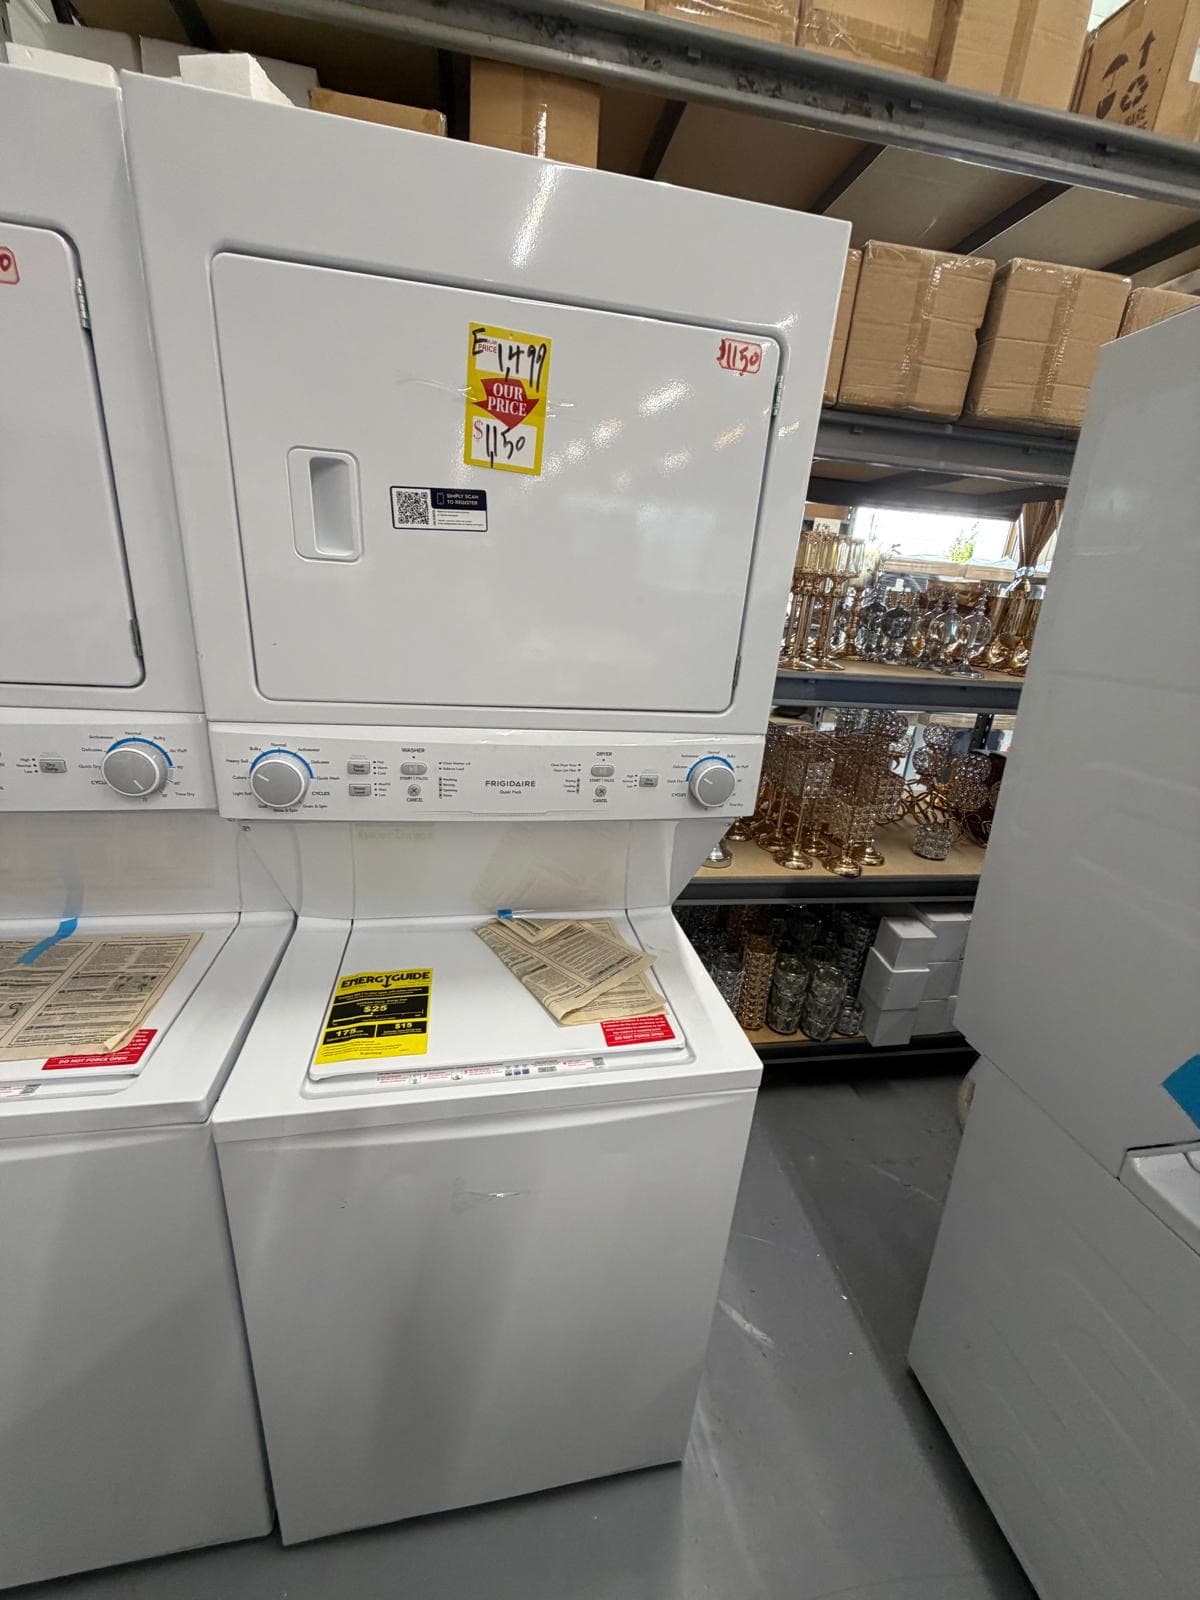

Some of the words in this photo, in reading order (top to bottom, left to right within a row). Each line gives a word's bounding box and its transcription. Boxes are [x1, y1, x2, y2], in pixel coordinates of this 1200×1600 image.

[478, 343, 497, 354] PRICE
[493, 382, 523, 401] OUR
[487, 396, 527, 417] PRICE
[341, 971, 431, 988] ENERGYGUIDE
[363, 1004, 388, 1013] $25
[394, 1022, 413, 1030] $15
[336, 1028, 357, 1037] 175
